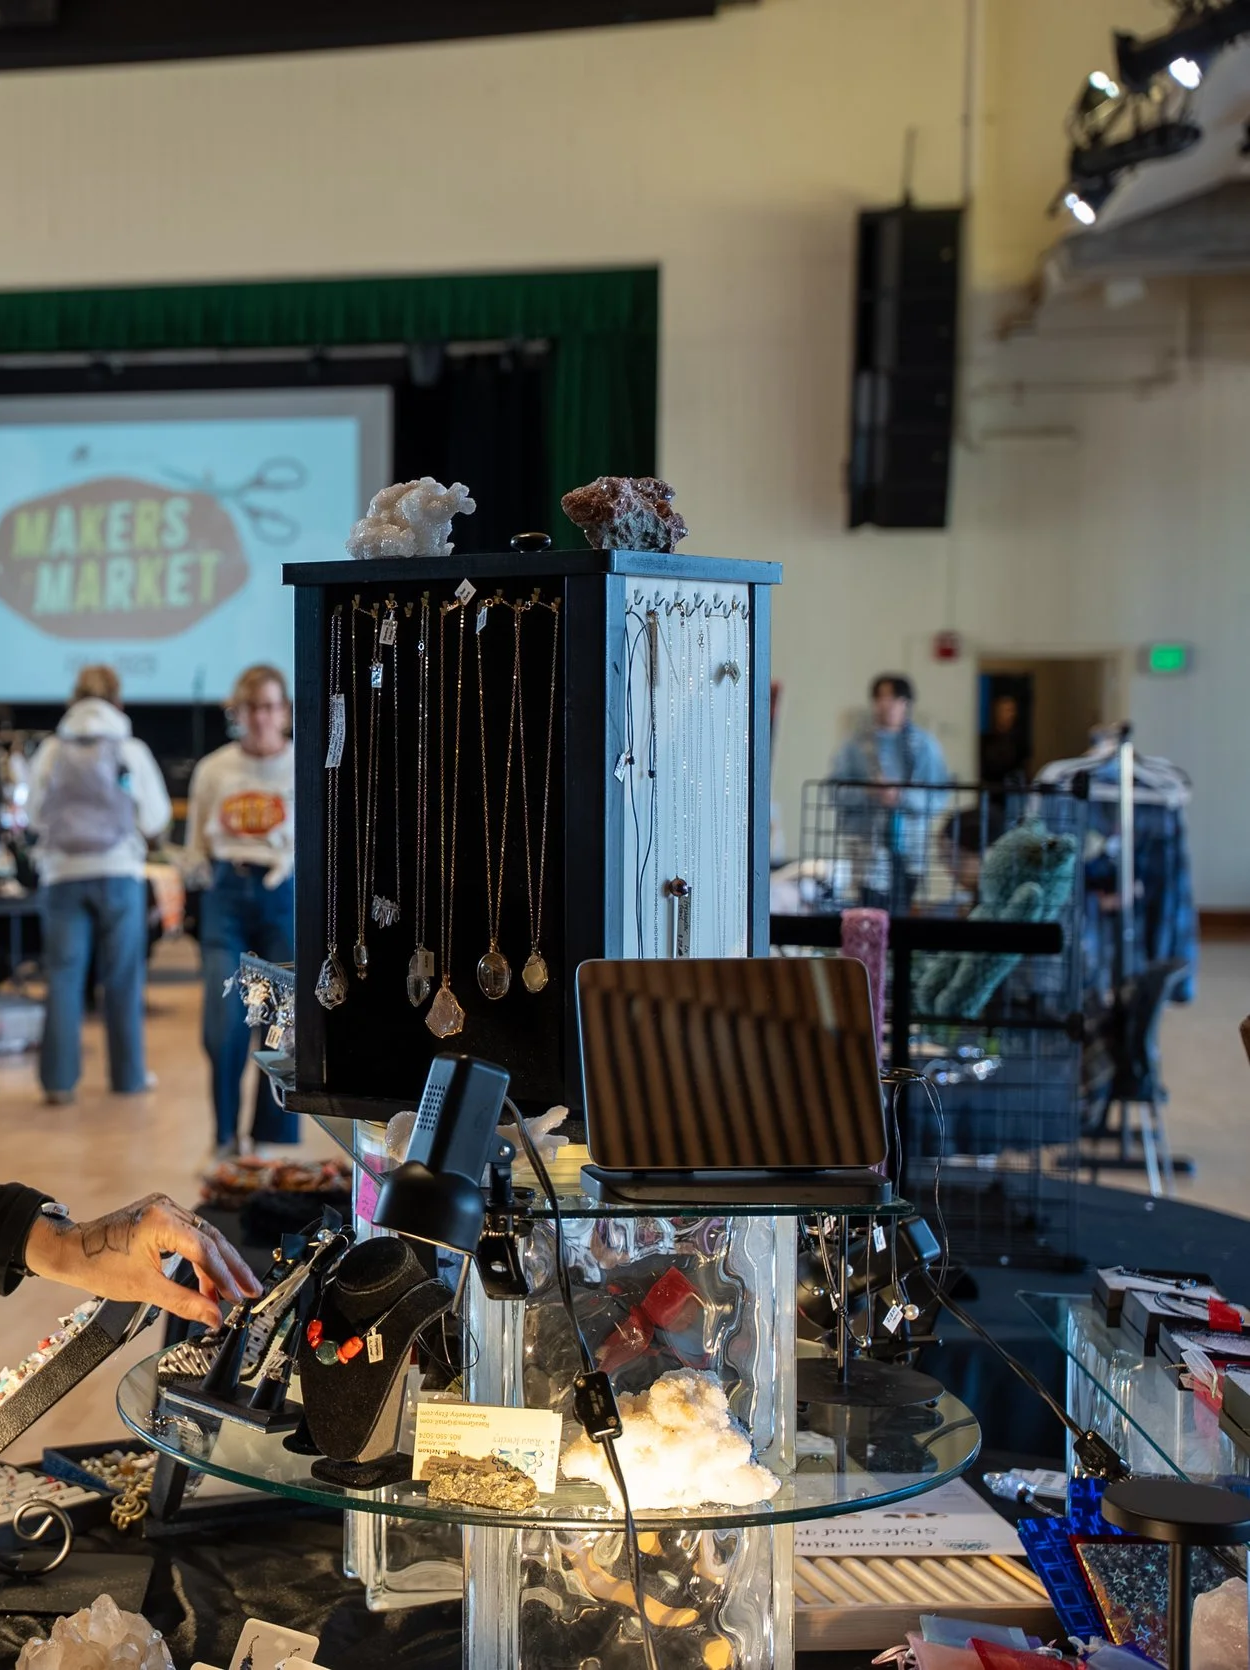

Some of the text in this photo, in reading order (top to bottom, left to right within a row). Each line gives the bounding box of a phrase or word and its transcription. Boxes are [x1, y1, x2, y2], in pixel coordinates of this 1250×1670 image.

[12, 498, 190, 556] MAKERS
[33, 550, 221, 614] MARKET
[417, 1447, 441, 1455] Nelson
[821, 1528, 864, 1537] and
[872, 1526, 938, 1536] Styles
[849, 1540, 933, 1548] Custom
